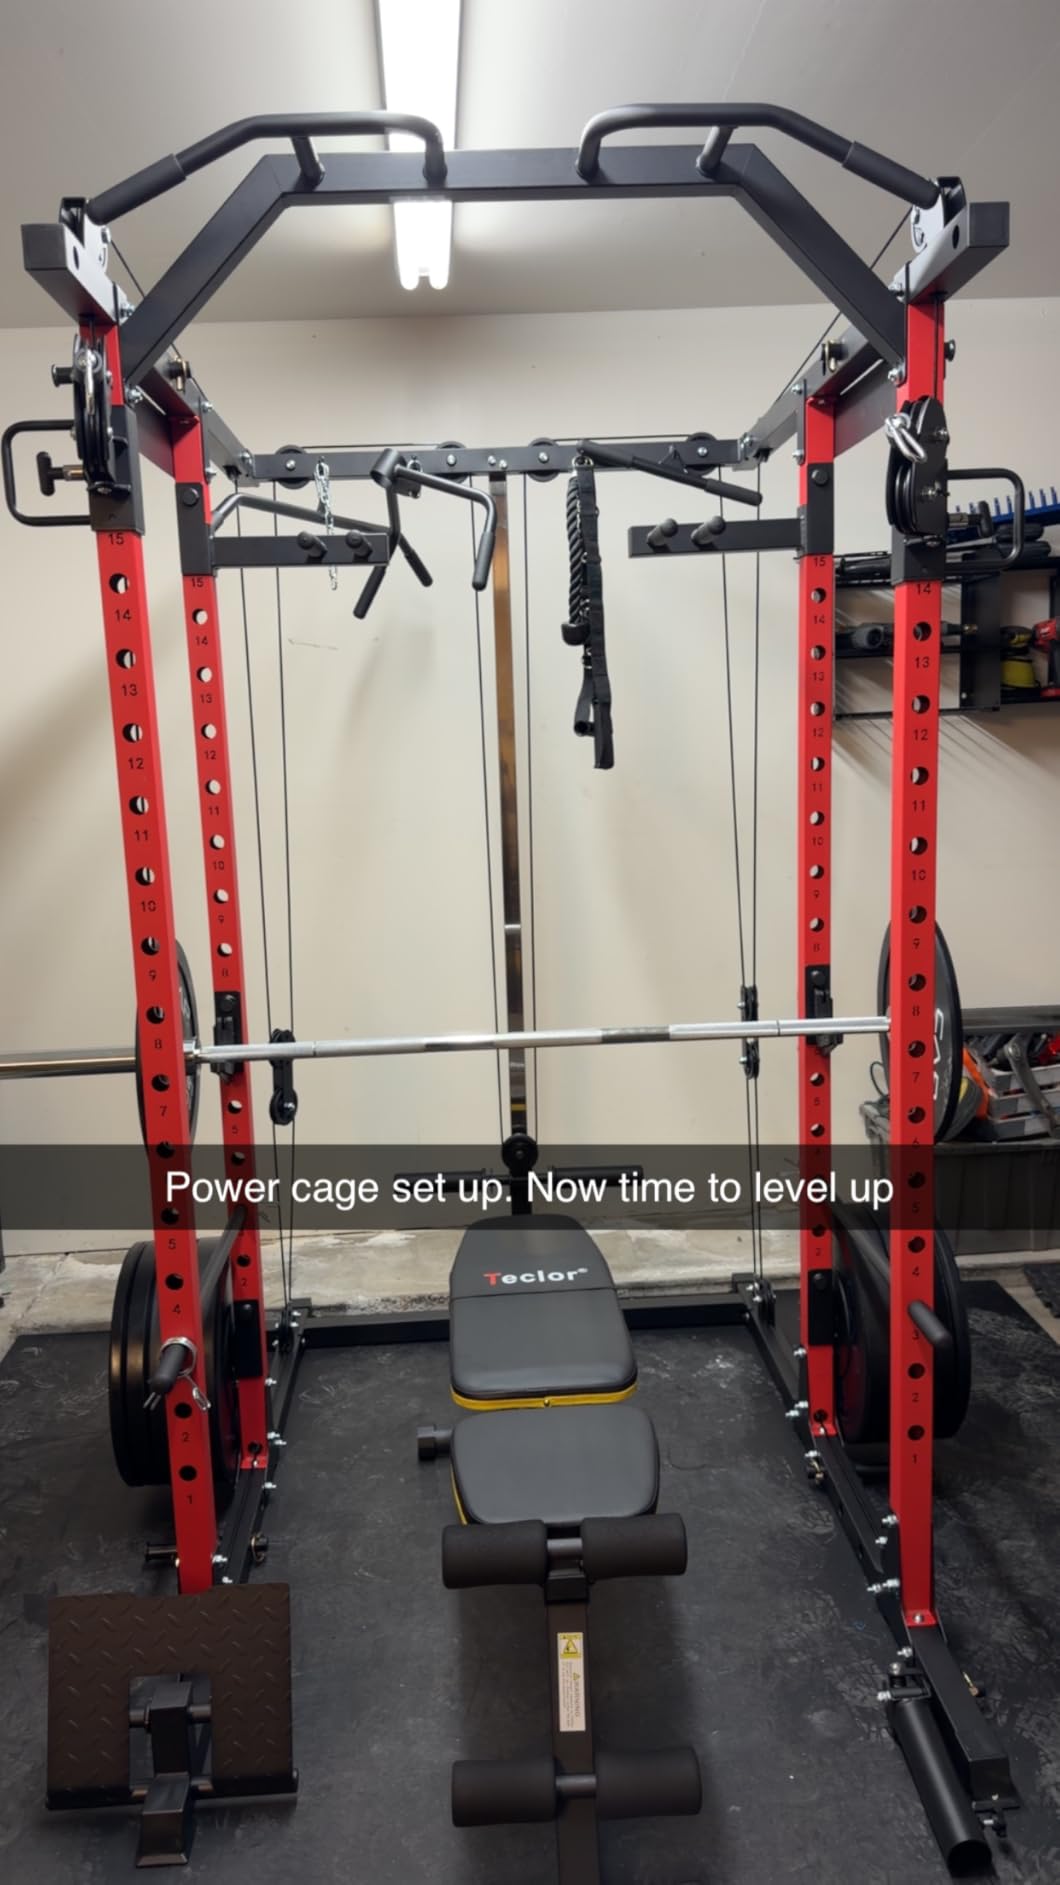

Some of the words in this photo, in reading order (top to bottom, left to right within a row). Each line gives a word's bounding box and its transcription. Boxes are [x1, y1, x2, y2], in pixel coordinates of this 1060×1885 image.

[108, 533, 124, 545] 15
[813, 557, 826, 567] 15
[191, 577, 204, 588] 15
[916, 583, 932, 595] 14
[116, 609, 131, 620] 14
[814, 615, 825, 624] 14
[196, 636, 208, 645] 14
[915, 656, 929, 668] 13
[813, 672, 824, 682] 13
[122, 684, 138, 696] 13
[200, 693, 212, 703] 13
[813, 728, 824, 737] 12
[914, 729, 928, 741] 12
[204, 750, 216, 760] 12
[128, 757, 143, 769] 12
[813, 783, 822, 792] 11
[208, 806, 219, 816] 11
[913, 800, 925, 811] 11
[134, 830, 148, 840] 11
[812, 837, 824, 845] 10
[213, 861, 224, 870] 10
[912, 869, 926, 880] 10
[812, 889, 821, 899] 9
[141, 900, 156, 912] 10
[217, 914, 225, 925] 9
[912, 937, 921, 950] 9
[148, 969, 157, 982] 9
[911, 1005, 921, 1017] 8
[154, 1038, 163, 1050] 8
[911, 1071, 921, 1083] 7
[159, 1104, 168, 1117] 7
[231, 1124, 239, 1135] 5
[167, 1237, 177, 1250] 5
[483, 1269, 579, 1286] Teclor
[911, 1266, 921, 1278] 4
[171, 1303, 182, 1315] 4
[911, 1391, 920, 1404] 2
[181, 1431, 190, 1443] 2
[911, 1453, 918, 1465] 1
[186, 1493, 193, 1505] 1
